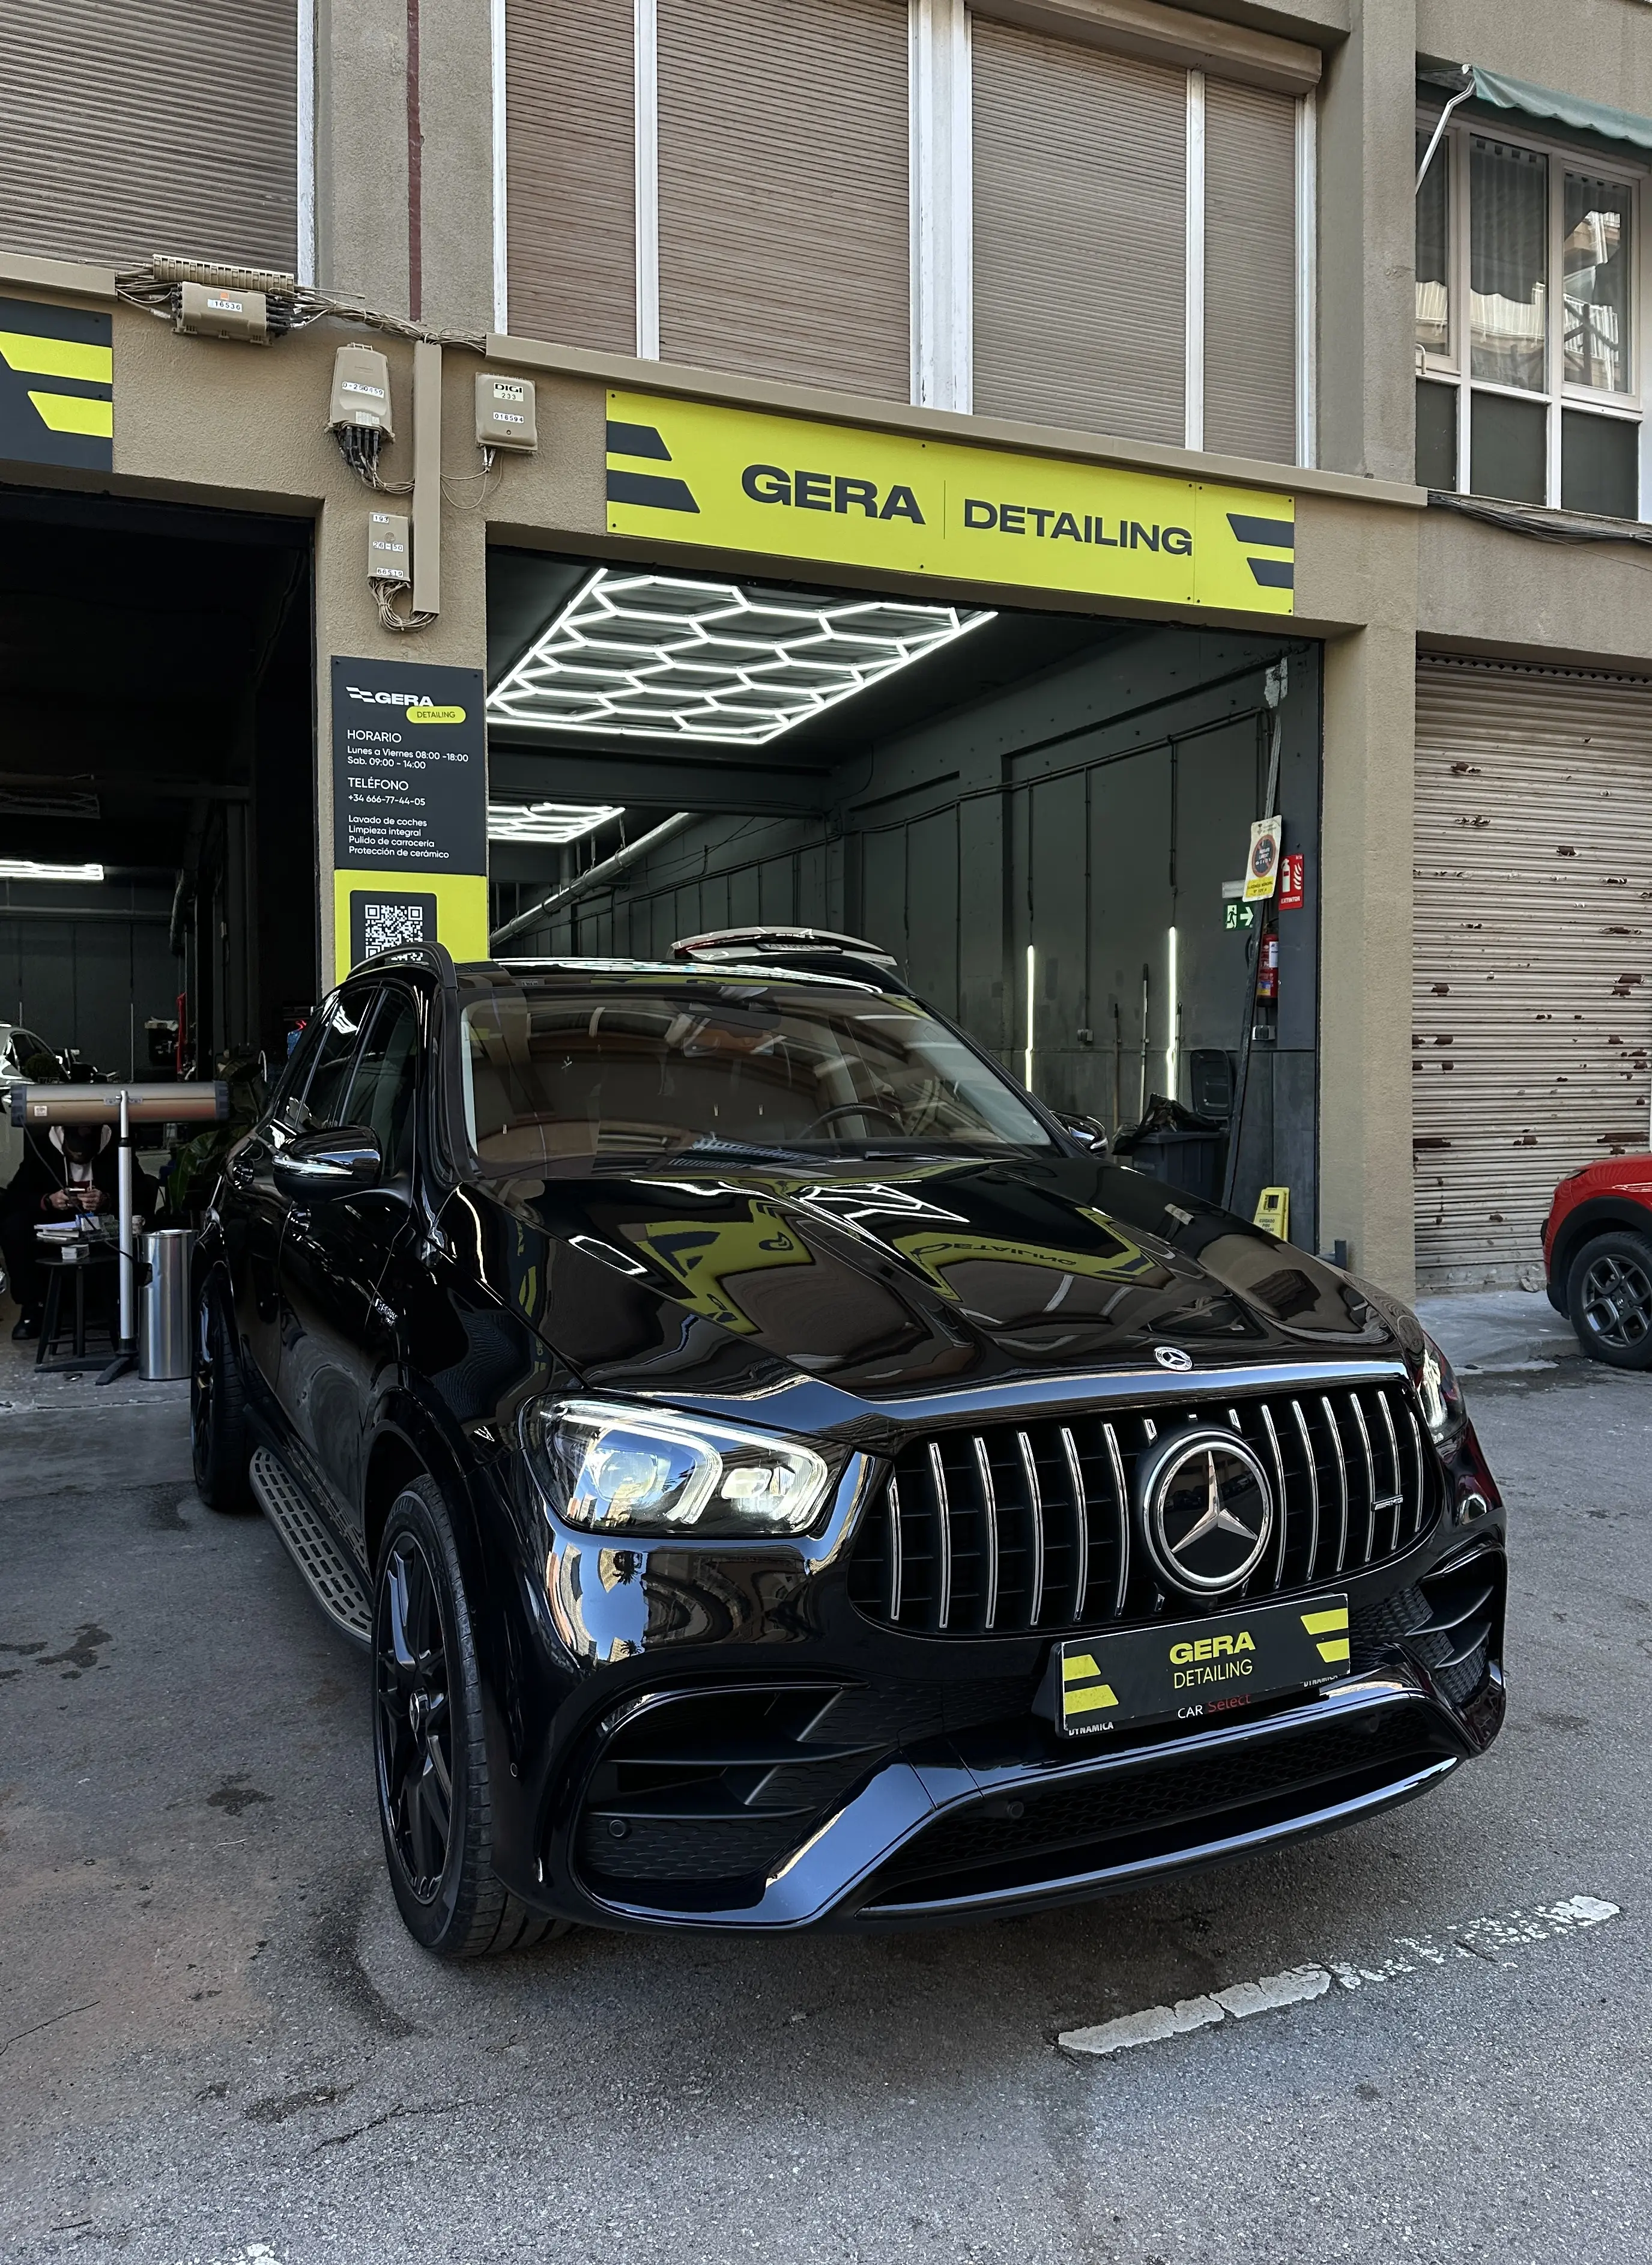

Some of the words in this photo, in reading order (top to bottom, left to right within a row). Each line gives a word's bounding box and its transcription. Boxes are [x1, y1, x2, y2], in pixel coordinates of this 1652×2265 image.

[215, 301, 240, 310] 16536
[495, 384, 522, 393] DIGI
[495, 413, 523, 422] 016594
[742, 464, 926, 525] GERA
[964, 499, 1193, 556] DETAILING
[375, 692, 434, 707] GERA
[347, 729, 402, 743] HORARIO
[347, 745, 372, 755] Lunes
[383, 748, 414, 758] Viernes
[416, 751, 440, 759] 08:00
[347, 756, 367, 765] Sab.
[369, 757, 395, 766] 09:00
[403, 760, 426, 769] 14:00
[348, 777, 409, 790] TELÉFONO
[348, 793, 364, 802] +34
[366, 795, 426, 805] 666-77-44-05
[348, 814, 381, 824] Lavado
[396, 818, 428, 826] coches
[348, 825, 386, 835] Limpieza
[389, 827, 421, 837] integral
[349, 835, 376, 844] Pulido
[349, 846, 395, 856] Protección
[396, 848, 408, 857] de
[410, 849, 449, 858] cerámico
[1170, 1631, 1256, 1665] GERA
[1174, 1659, 1253, 1689] DETAILING
[1178, 1705, 1203, 1718] CAR
[1208, 1694, 1251, 1712] Select
[1069, 1721, 1114, 1736] DYNAMICA
